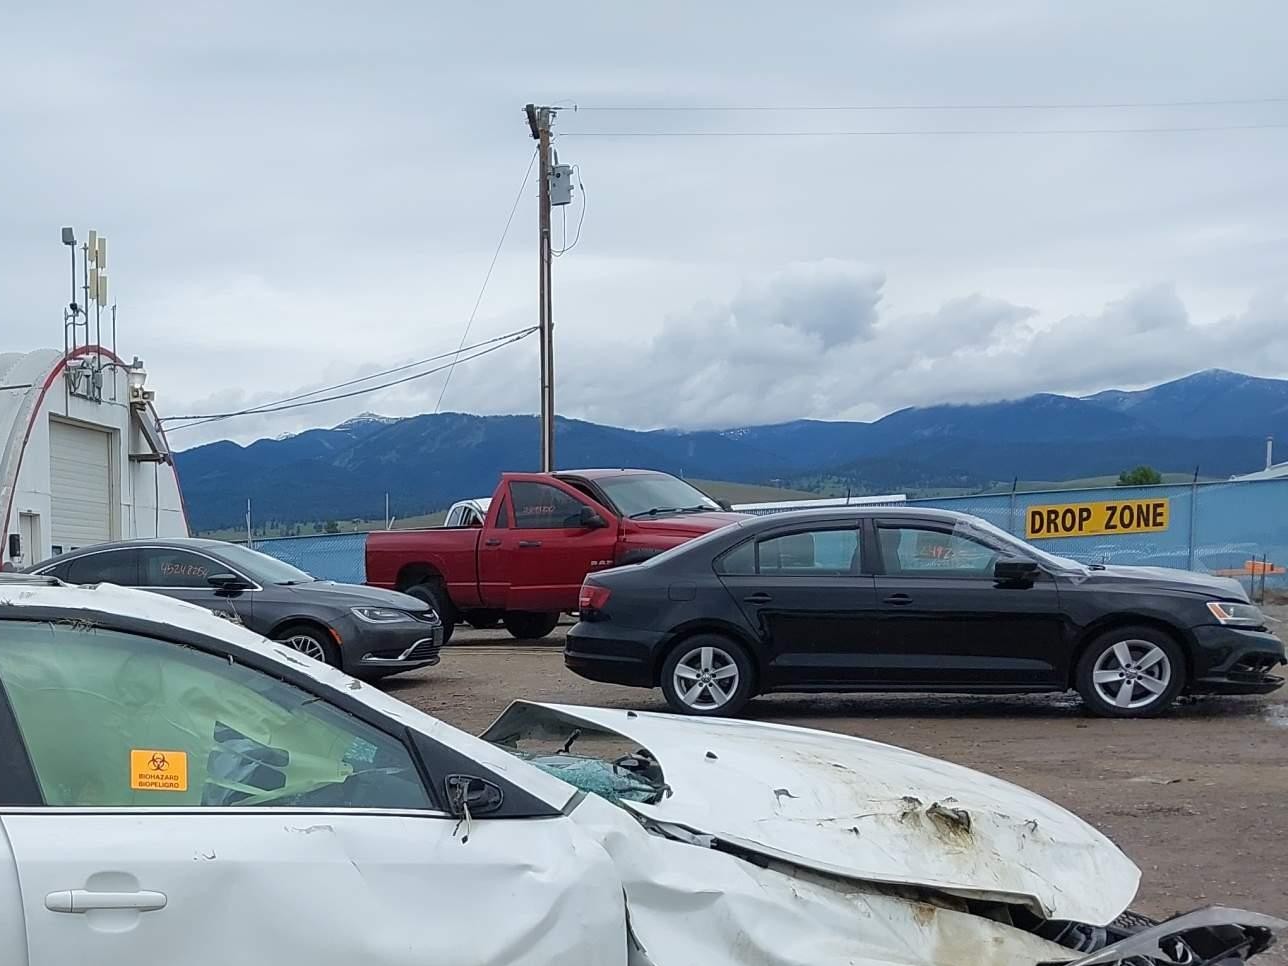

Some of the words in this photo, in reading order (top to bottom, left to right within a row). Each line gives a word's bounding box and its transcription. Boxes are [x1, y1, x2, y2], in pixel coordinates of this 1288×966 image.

[1030, 507, 1092, 534] DROP
[1104, 502, 1165, 530] ZONE
[138, 773, 179, 781] BIOHAZARD
[138, 781, 180, 789] BIOPELIGRO
